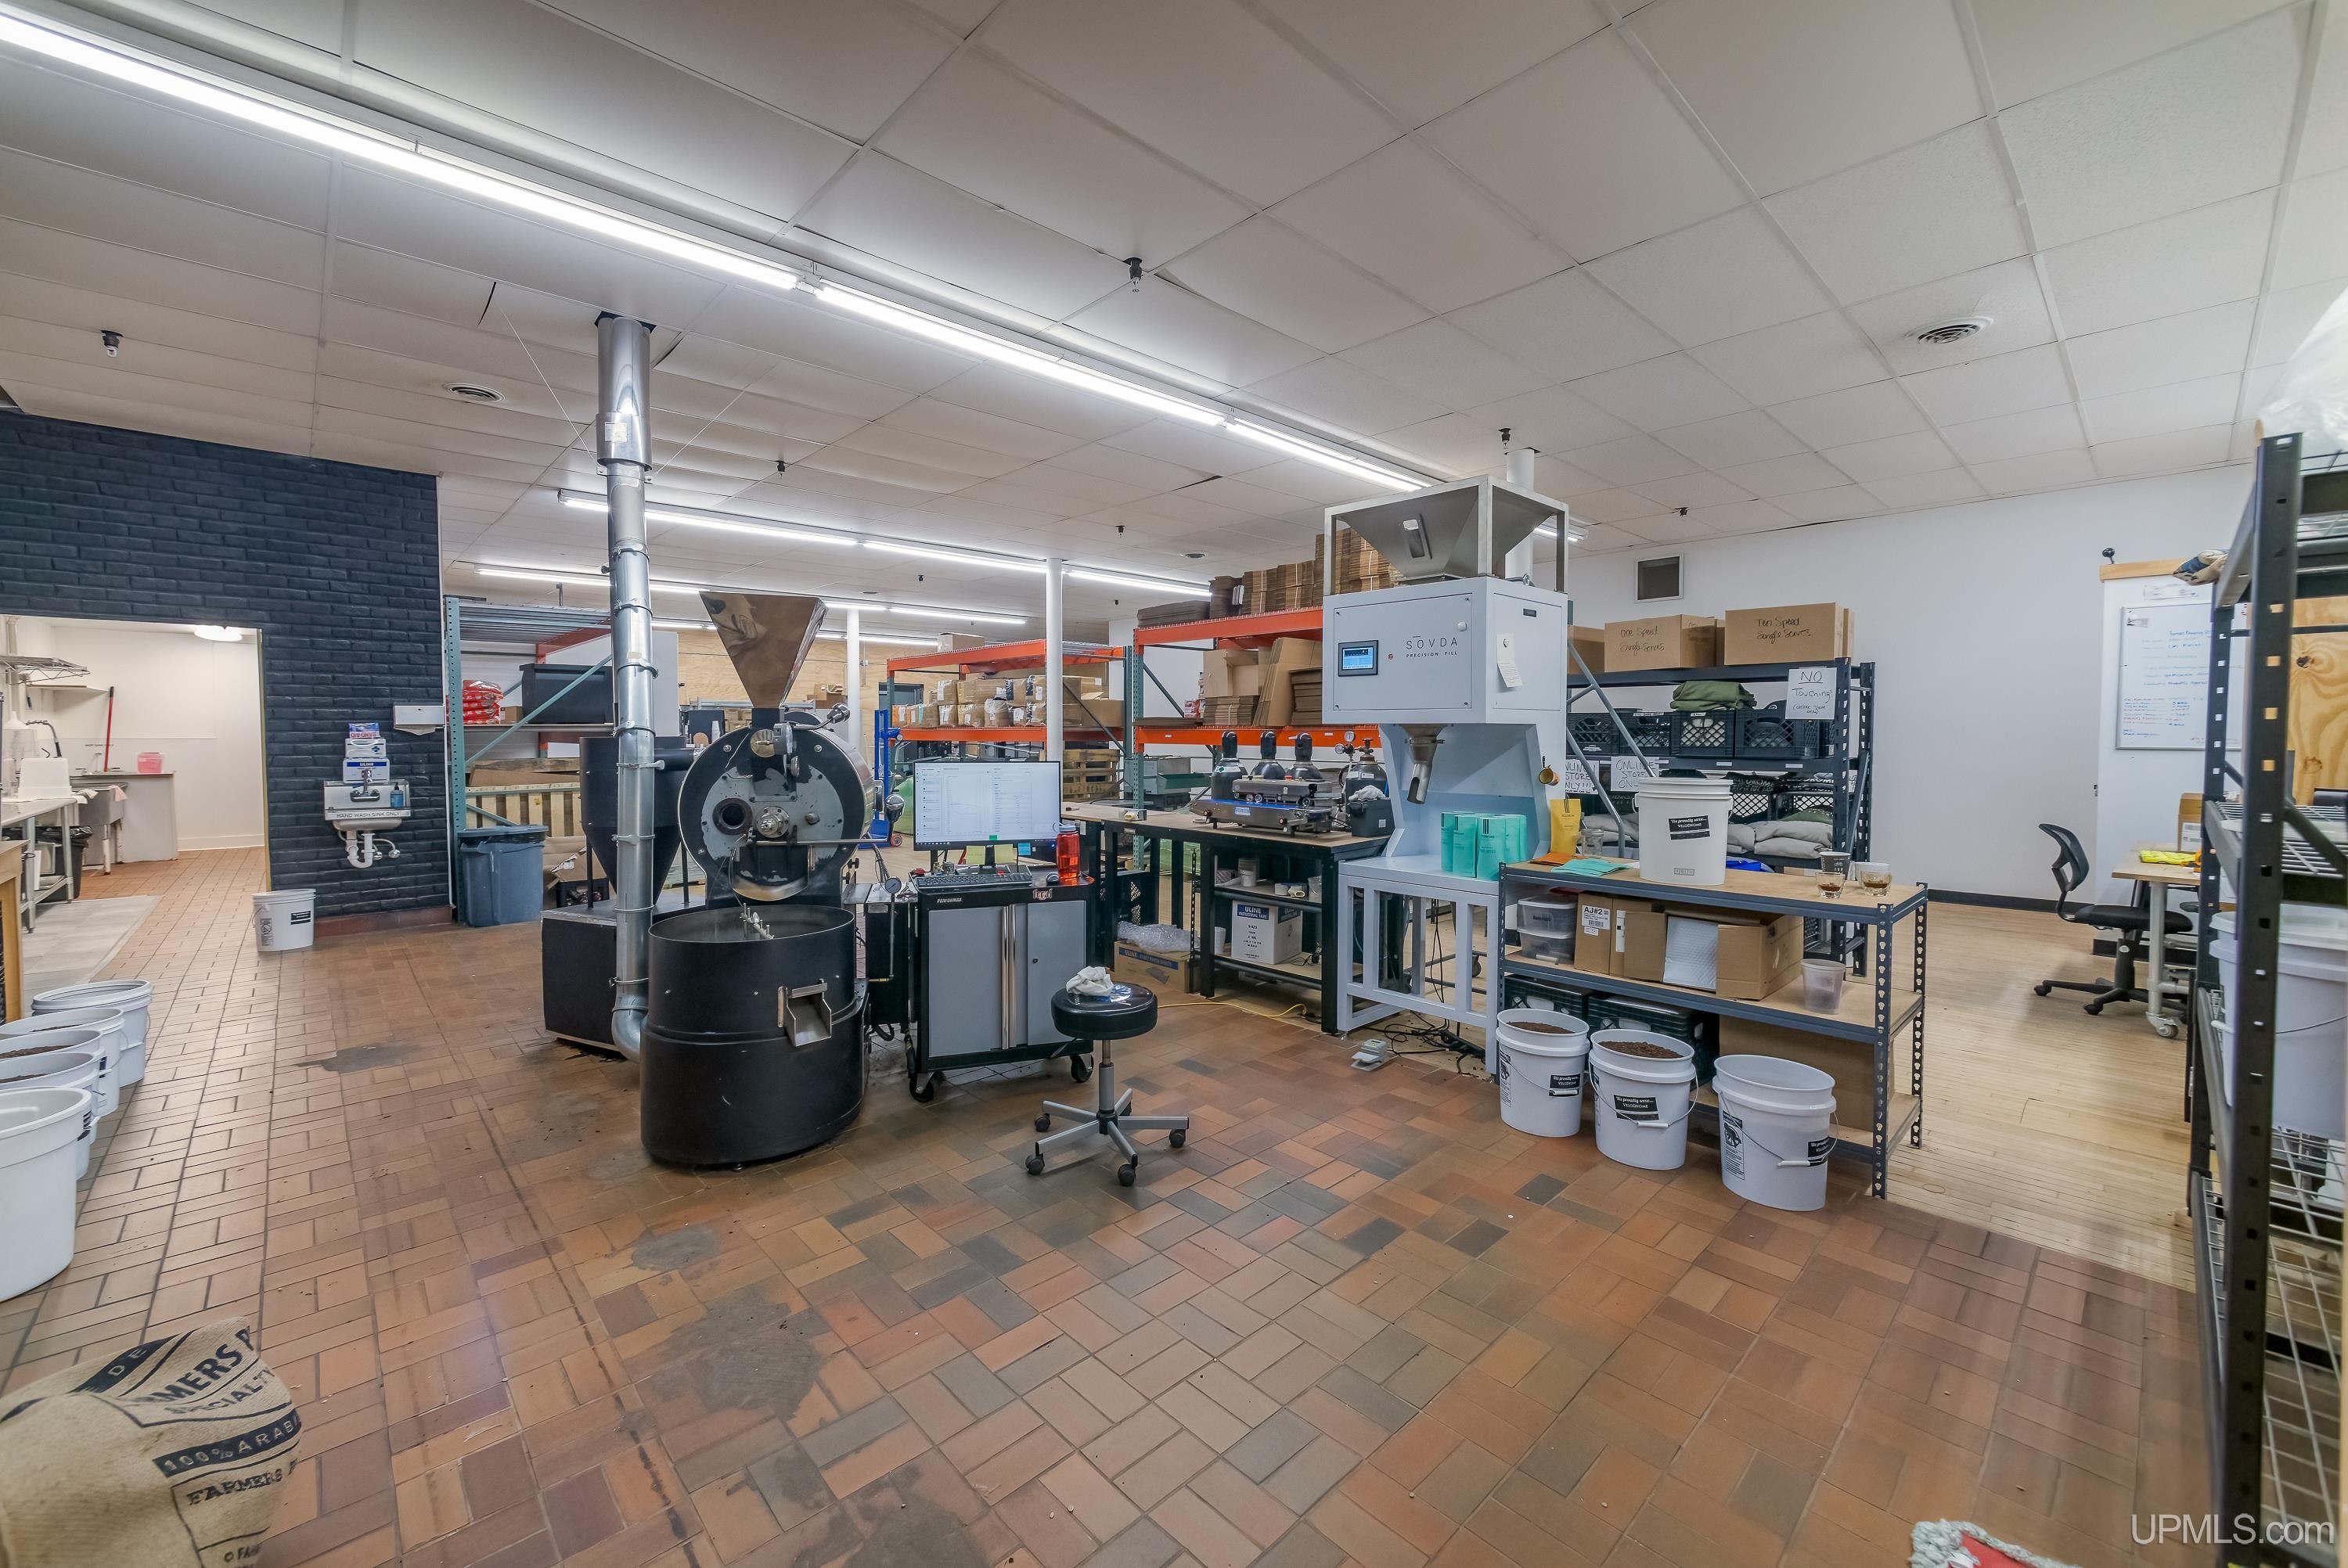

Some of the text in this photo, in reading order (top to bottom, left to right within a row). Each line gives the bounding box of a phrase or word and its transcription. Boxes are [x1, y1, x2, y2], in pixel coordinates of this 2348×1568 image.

[1800, 671, 1823, 682] NO
[1565, 782, 1591, 790] NLY!!!
[1584, 906, 1603, 915] AJ#2
